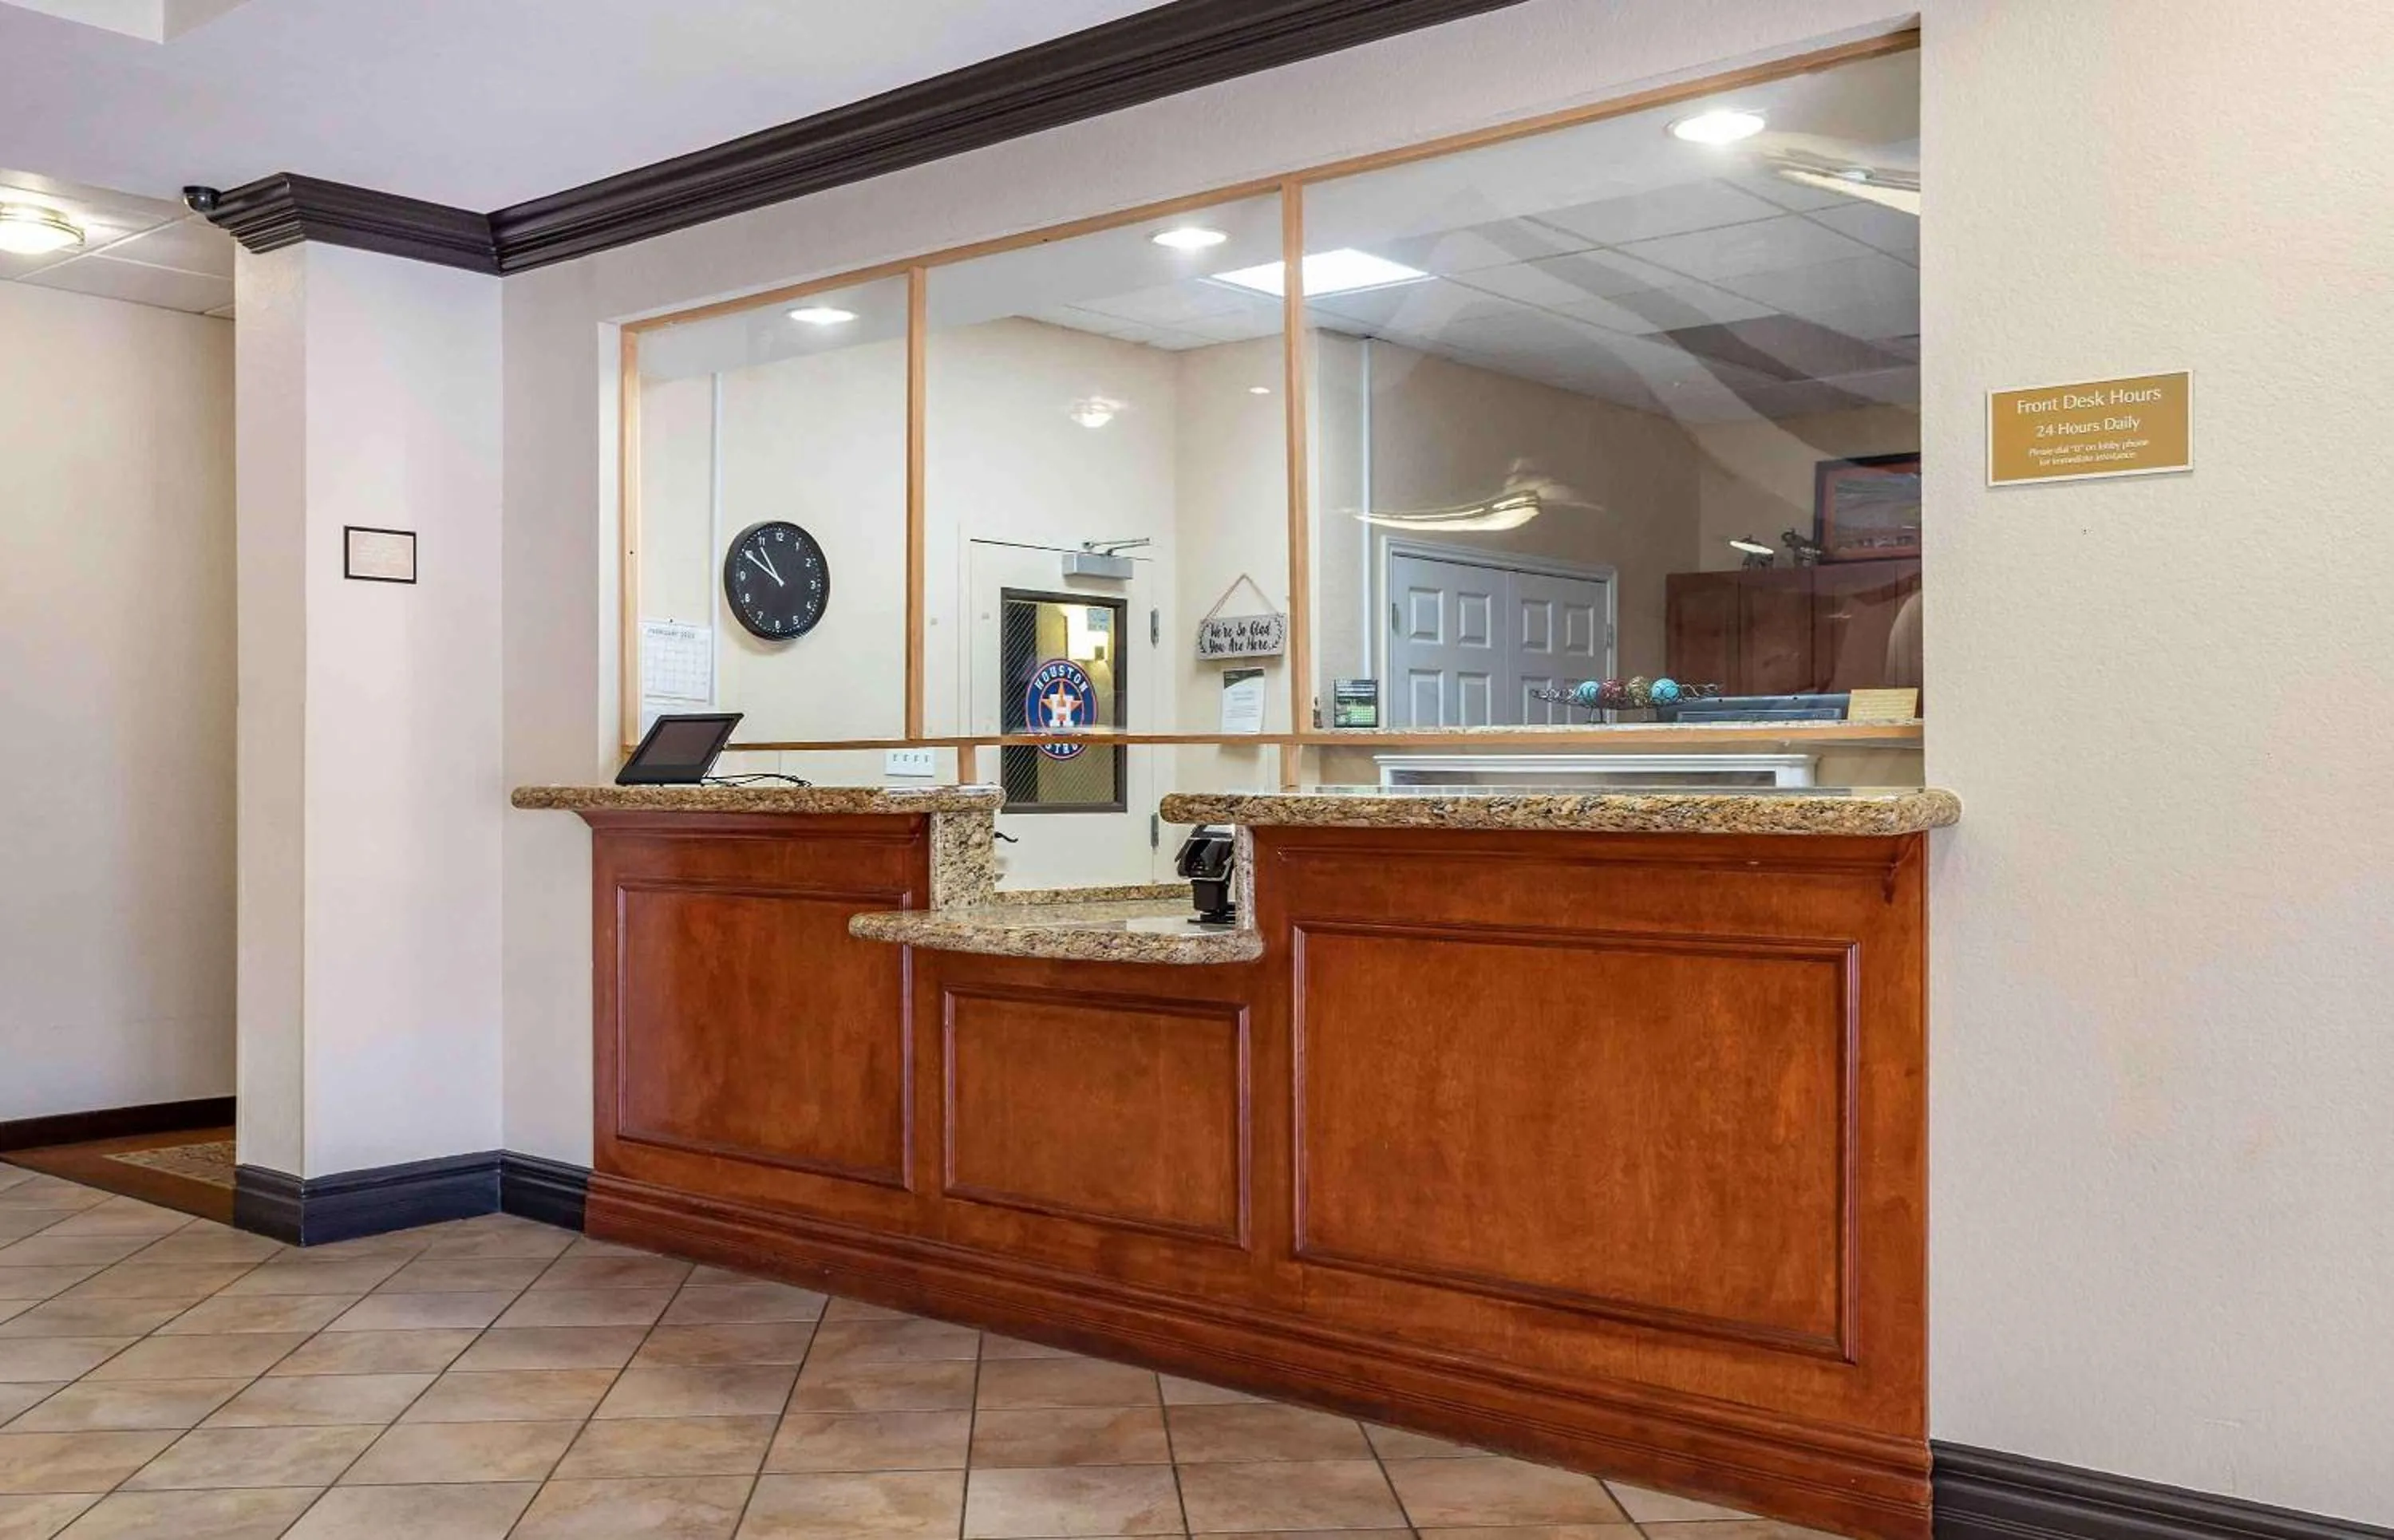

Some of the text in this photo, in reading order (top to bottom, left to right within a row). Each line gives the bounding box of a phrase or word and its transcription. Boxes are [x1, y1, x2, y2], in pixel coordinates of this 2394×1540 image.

[2017, 386, 2162, 415] Front Desk Hours
[2036, 415, 2140, 438] 24 Hours Daily
[2029, 448, 2052, 456] Please
[2098, 440, 2119, 451] lobby
[2122, 439, 2149, 450] phone
[2052, 453, 2094, 465] immediate
[2096, 451, 2136, 461] assistance
[776, 532, 784, 542] 12
[805, 559, 812, 567] 2
[810, 580, 816, 590] 3
[775, 620, 781, 629] 6
[792, 615, 799, 625] 5
[1210, 621, 1271, 638] We're So Glad
[1209, 638, 1226, 654] You
[1229, 638, 1243, 654] Are
[1034, 665, 1088, 693] HOUSTON
